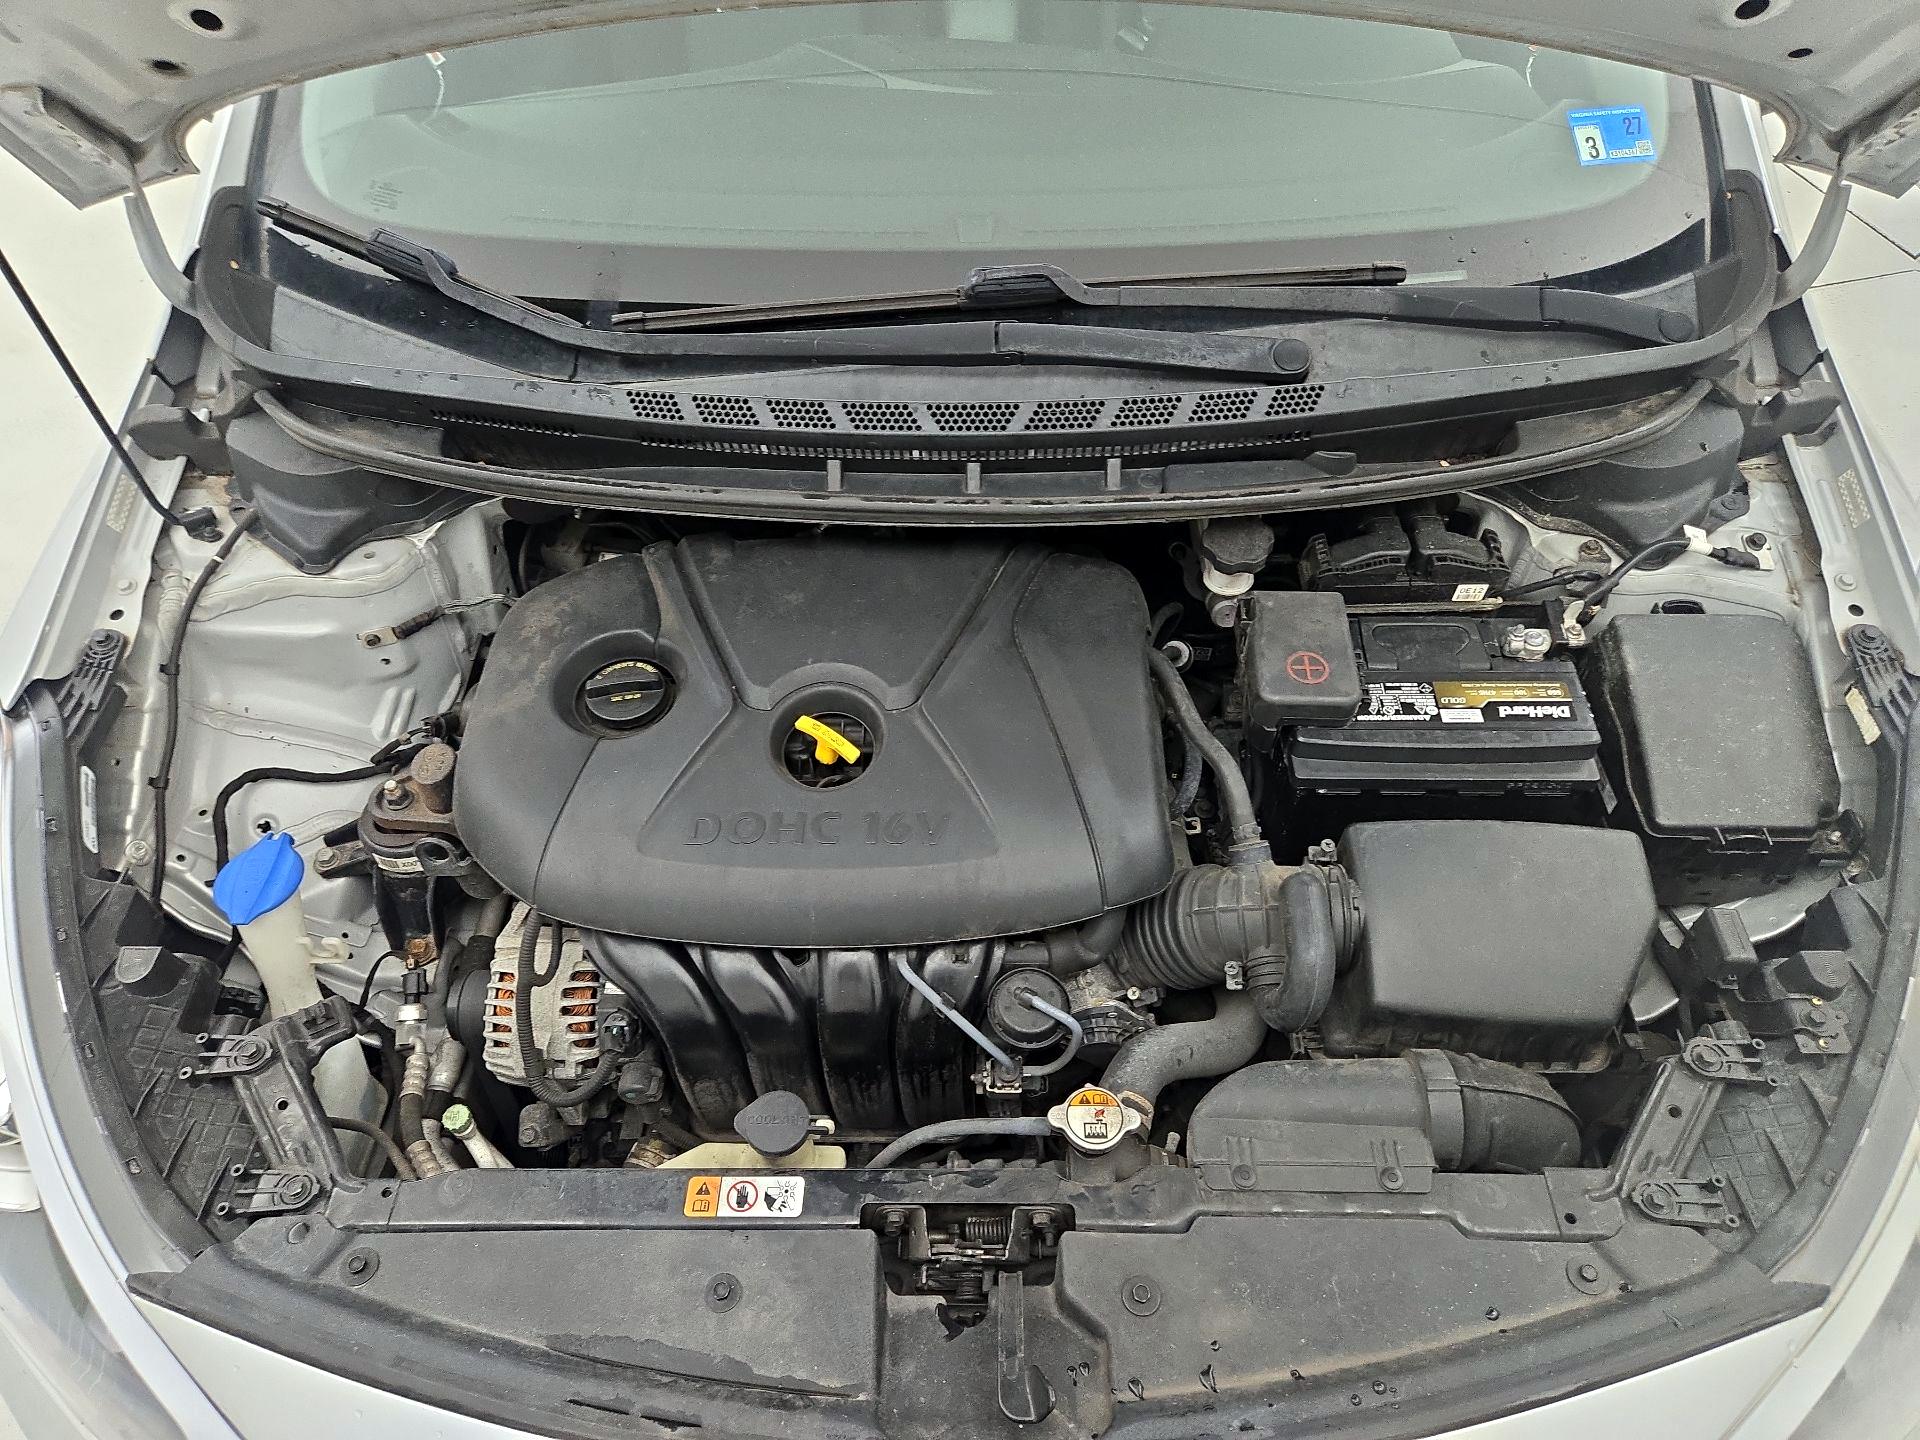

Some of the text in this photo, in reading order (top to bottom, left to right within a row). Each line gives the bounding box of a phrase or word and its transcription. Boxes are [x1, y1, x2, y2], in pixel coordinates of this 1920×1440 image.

[1622, 116, 1642, 136] 27
[1584, 136, 1600, 159] 3
[1441, 696, 1467, 704] GOLD
[1497, 705, 1571, 719] DieHard
[683, 811, 950, 845] DOHC 16V
